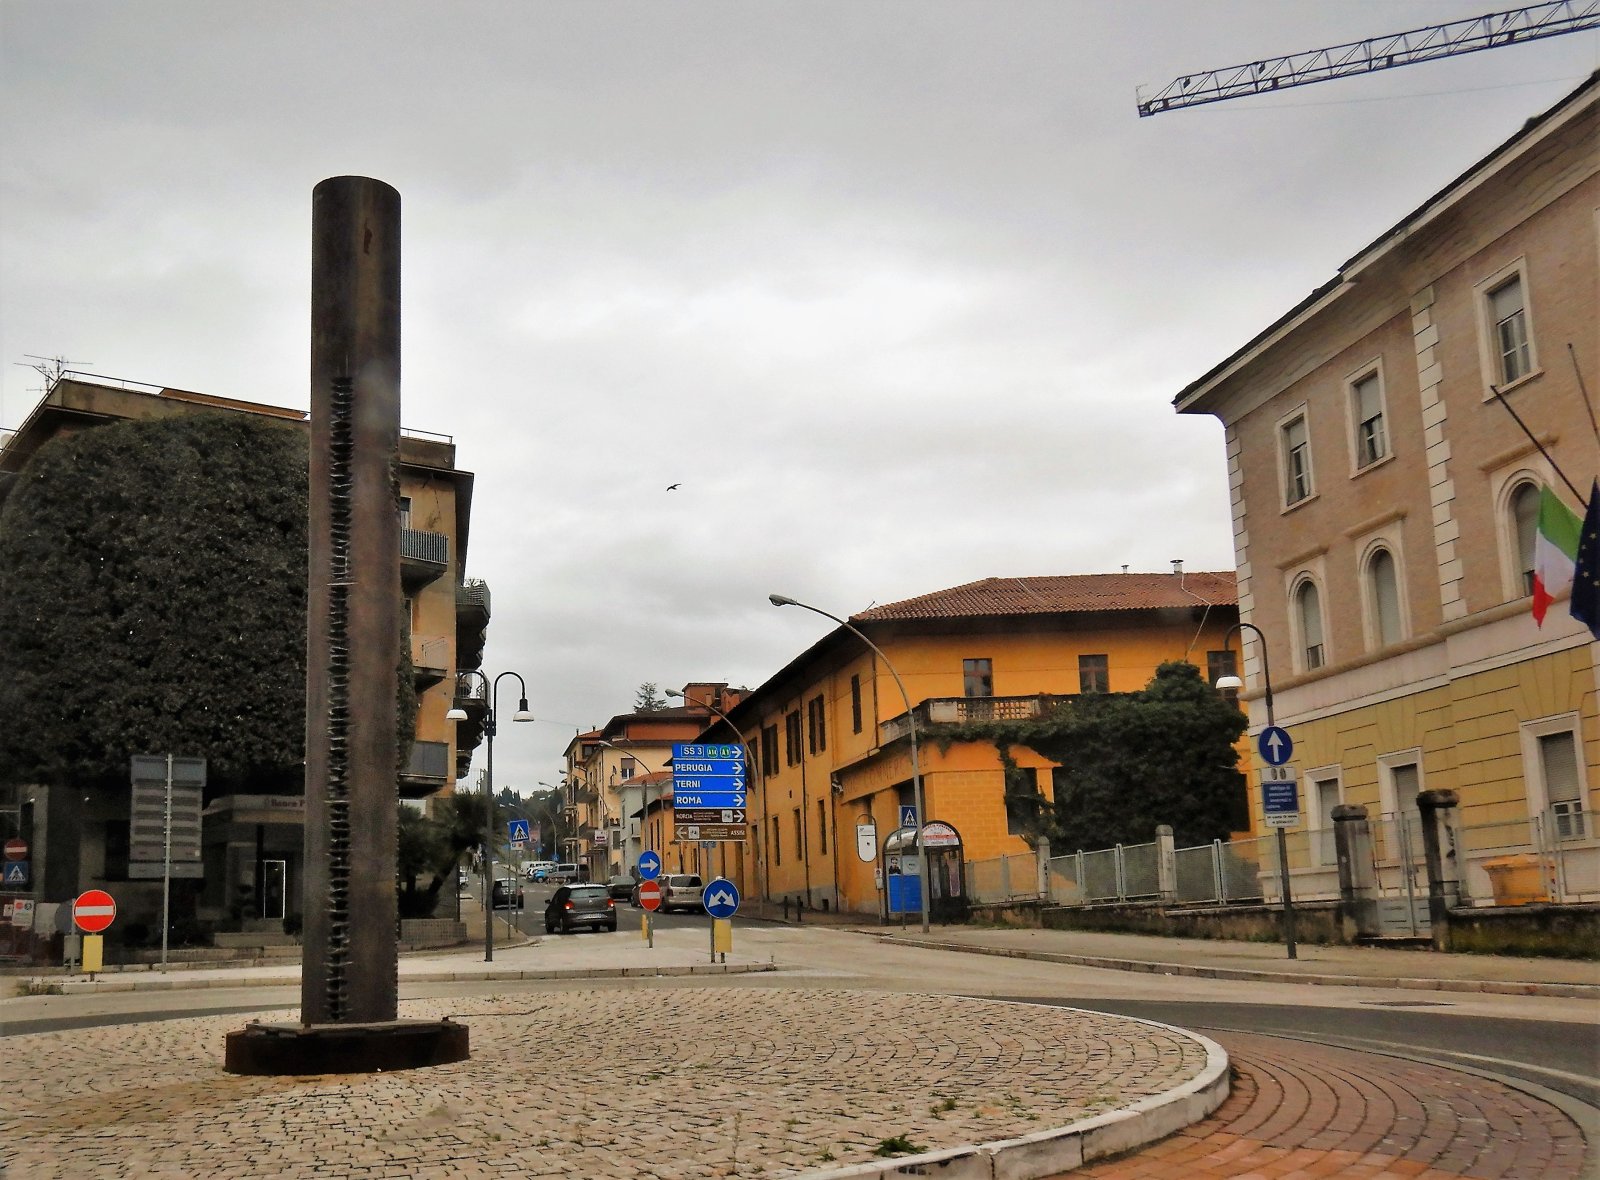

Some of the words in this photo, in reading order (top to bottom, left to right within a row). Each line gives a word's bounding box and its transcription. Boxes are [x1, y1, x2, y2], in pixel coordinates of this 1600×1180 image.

[675, 764, 712, 772] PERUGIA
[676, 780, 700, 788] TERNI
[676, 796, 702, 804] ROMA
